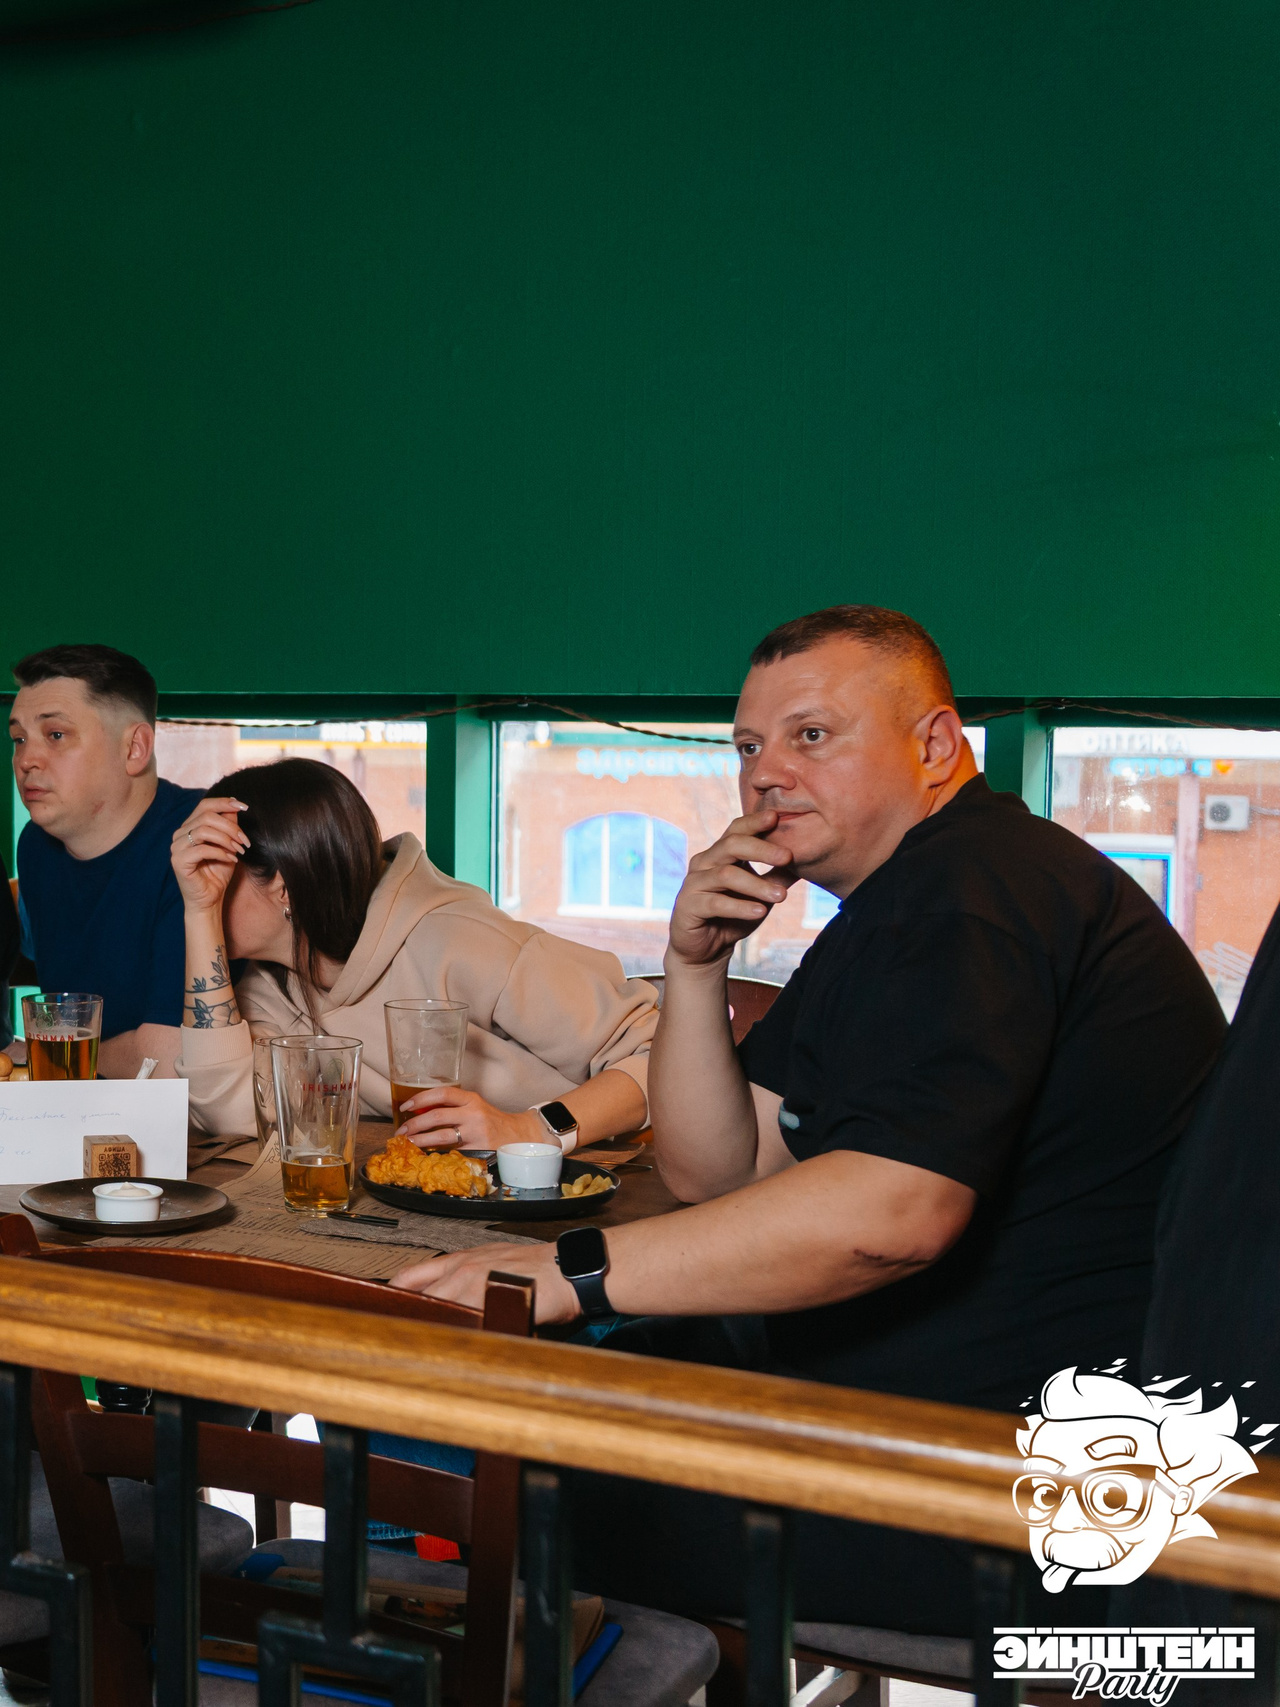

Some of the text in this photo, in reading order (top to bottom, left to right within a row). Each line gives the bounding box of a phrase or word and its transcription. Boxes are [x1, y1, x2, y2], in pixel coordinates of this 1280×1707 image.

[1081, 731, 1188, 754] ОПТИКА
[27, 1033, 75, 1042] RISHMAN
[303, 1083, 356, 1093] IRISHMA
